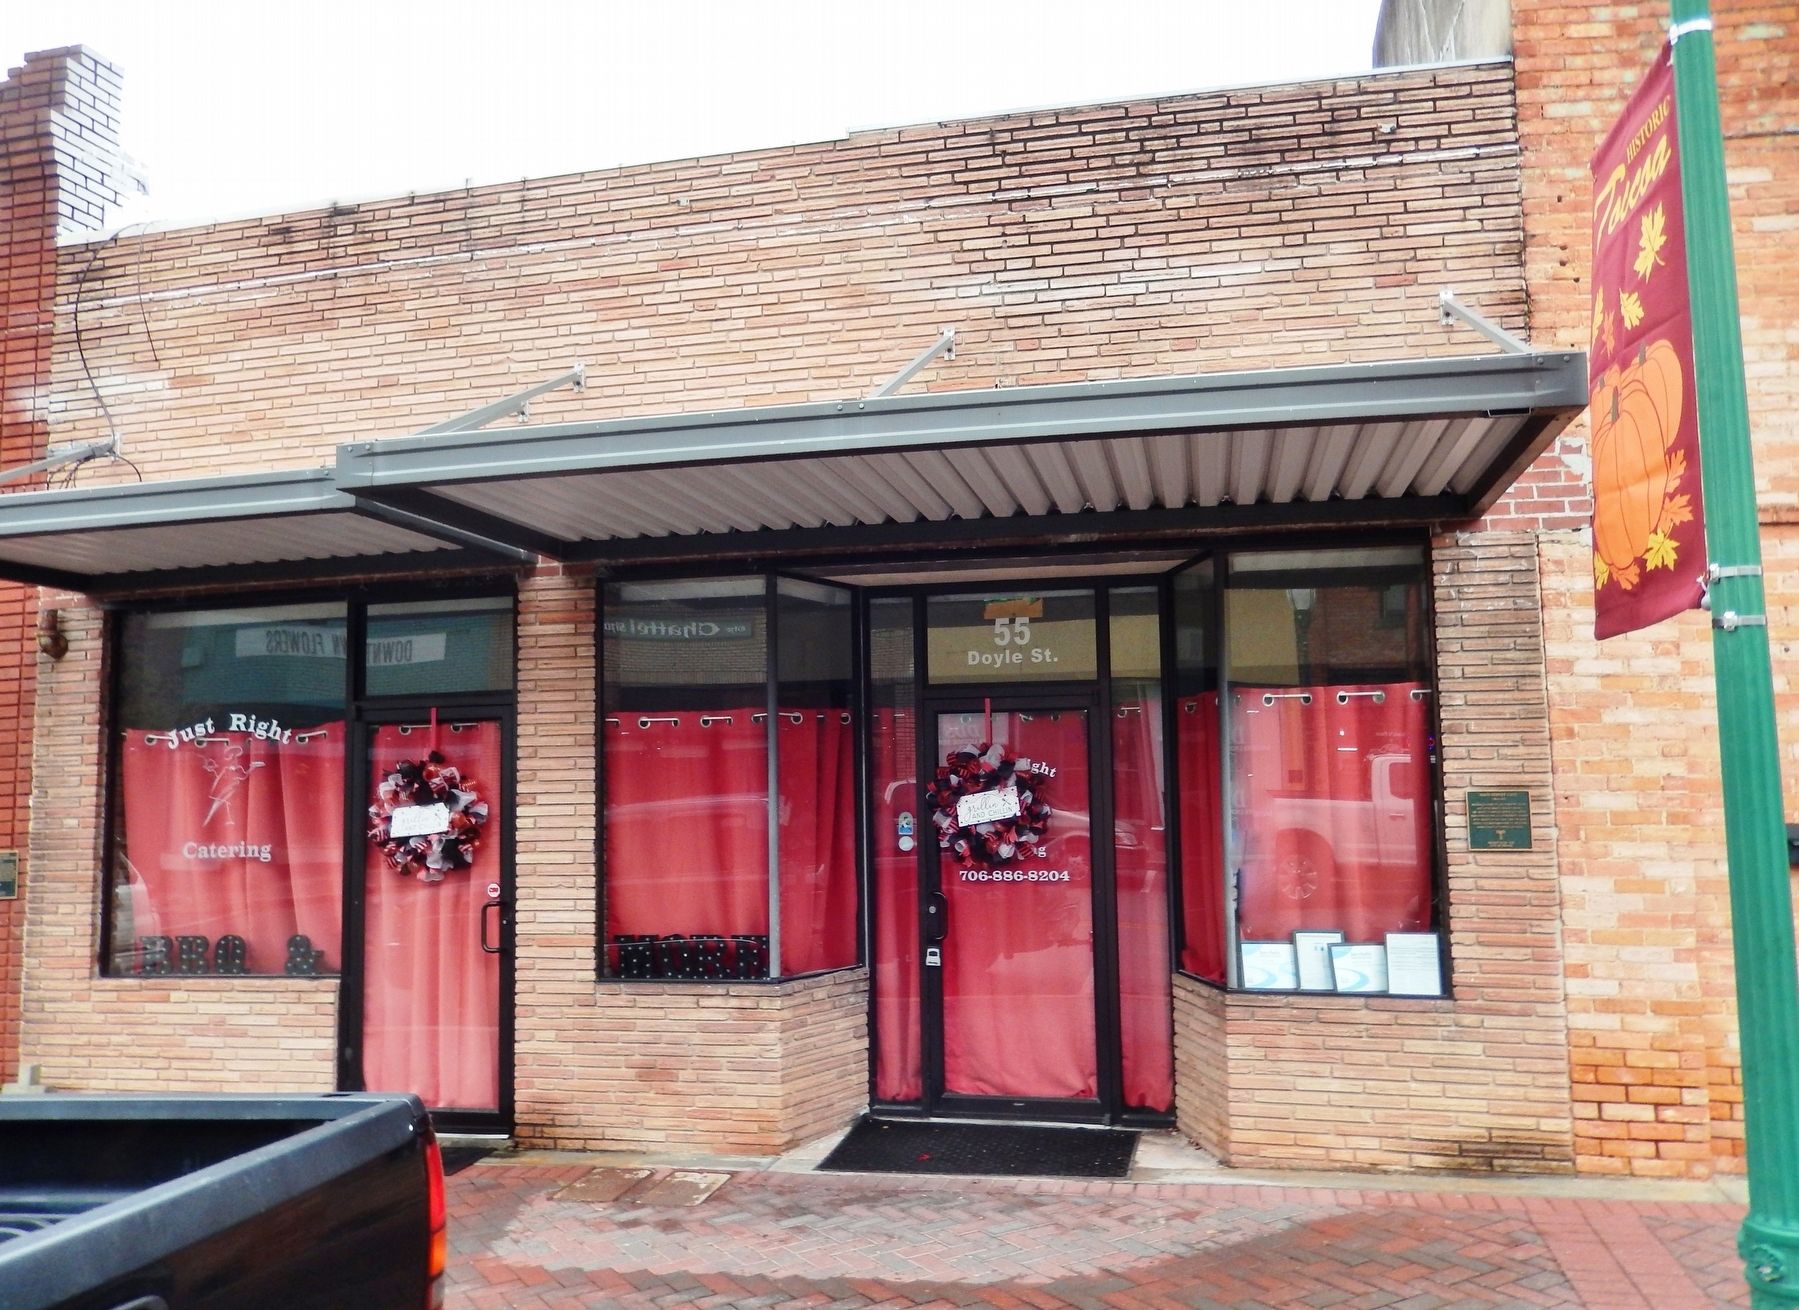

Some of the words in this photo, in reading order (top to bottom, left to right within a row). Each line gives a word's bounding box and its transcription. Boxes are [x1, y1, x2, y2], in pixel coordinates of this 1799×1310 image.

[1626, 94, 1671, 165] HISTORIC
[1593, 133, 1672, 255] Toccoa
[994, 616, 1031, 646] 55
[967, 649, 1023, 668] Doyle
[1031, 648, 1058, 663] St.
[167, 717, 215, 750] Just
[228, 713, 293, 745] Right
[1030, 760, 1057, 778] ght
[182, 841, 272, 862] Catering
[959, 870, 1070, 881] 706-886-8204
[140, 935, 249, 976] BBQ
[285, 935, 324, 976] &
[614, 933, 768, 978] MORE
